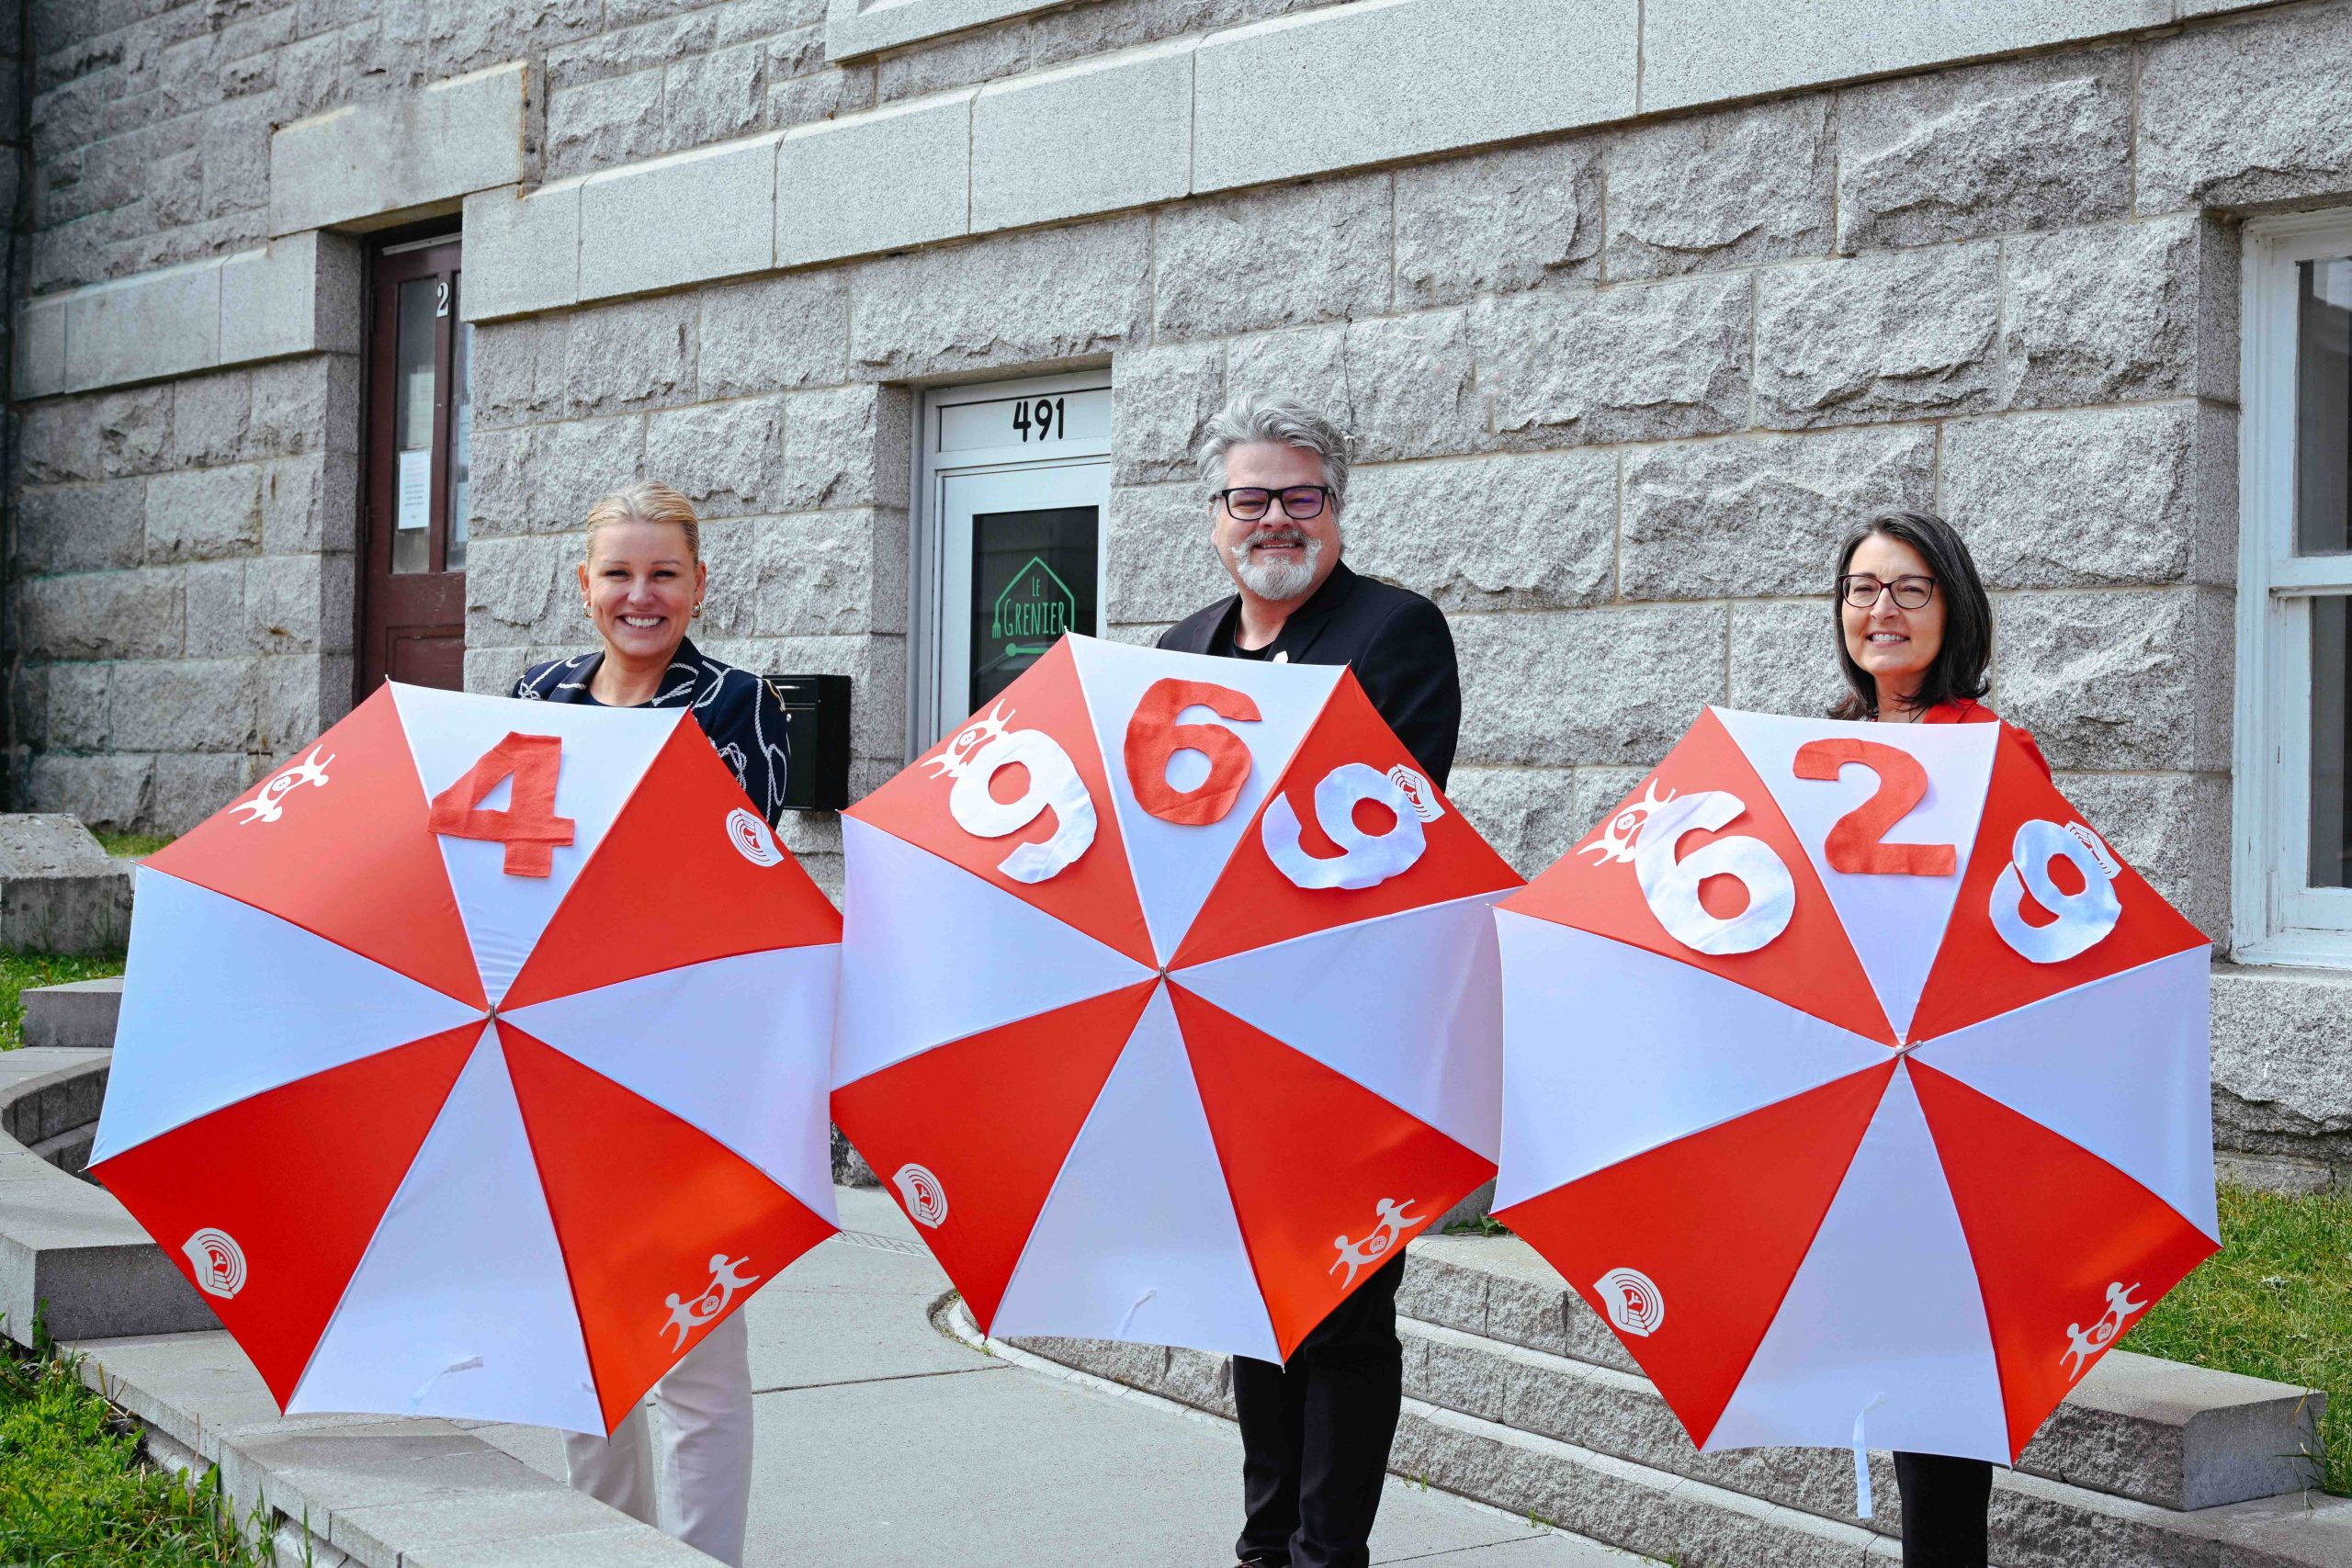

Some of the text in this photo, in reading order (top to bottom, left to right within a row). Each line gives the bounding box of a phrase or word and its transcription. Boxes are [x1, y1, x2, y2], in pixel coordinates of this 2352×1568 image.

[435, 282, 450, 318] 2
[1012, 397, 1065, 443] 491
[1031, 575, 1041, 597] LE
[1003, 598, 1065, 637] GRENIER
[427, 731, 575, 878] 4
